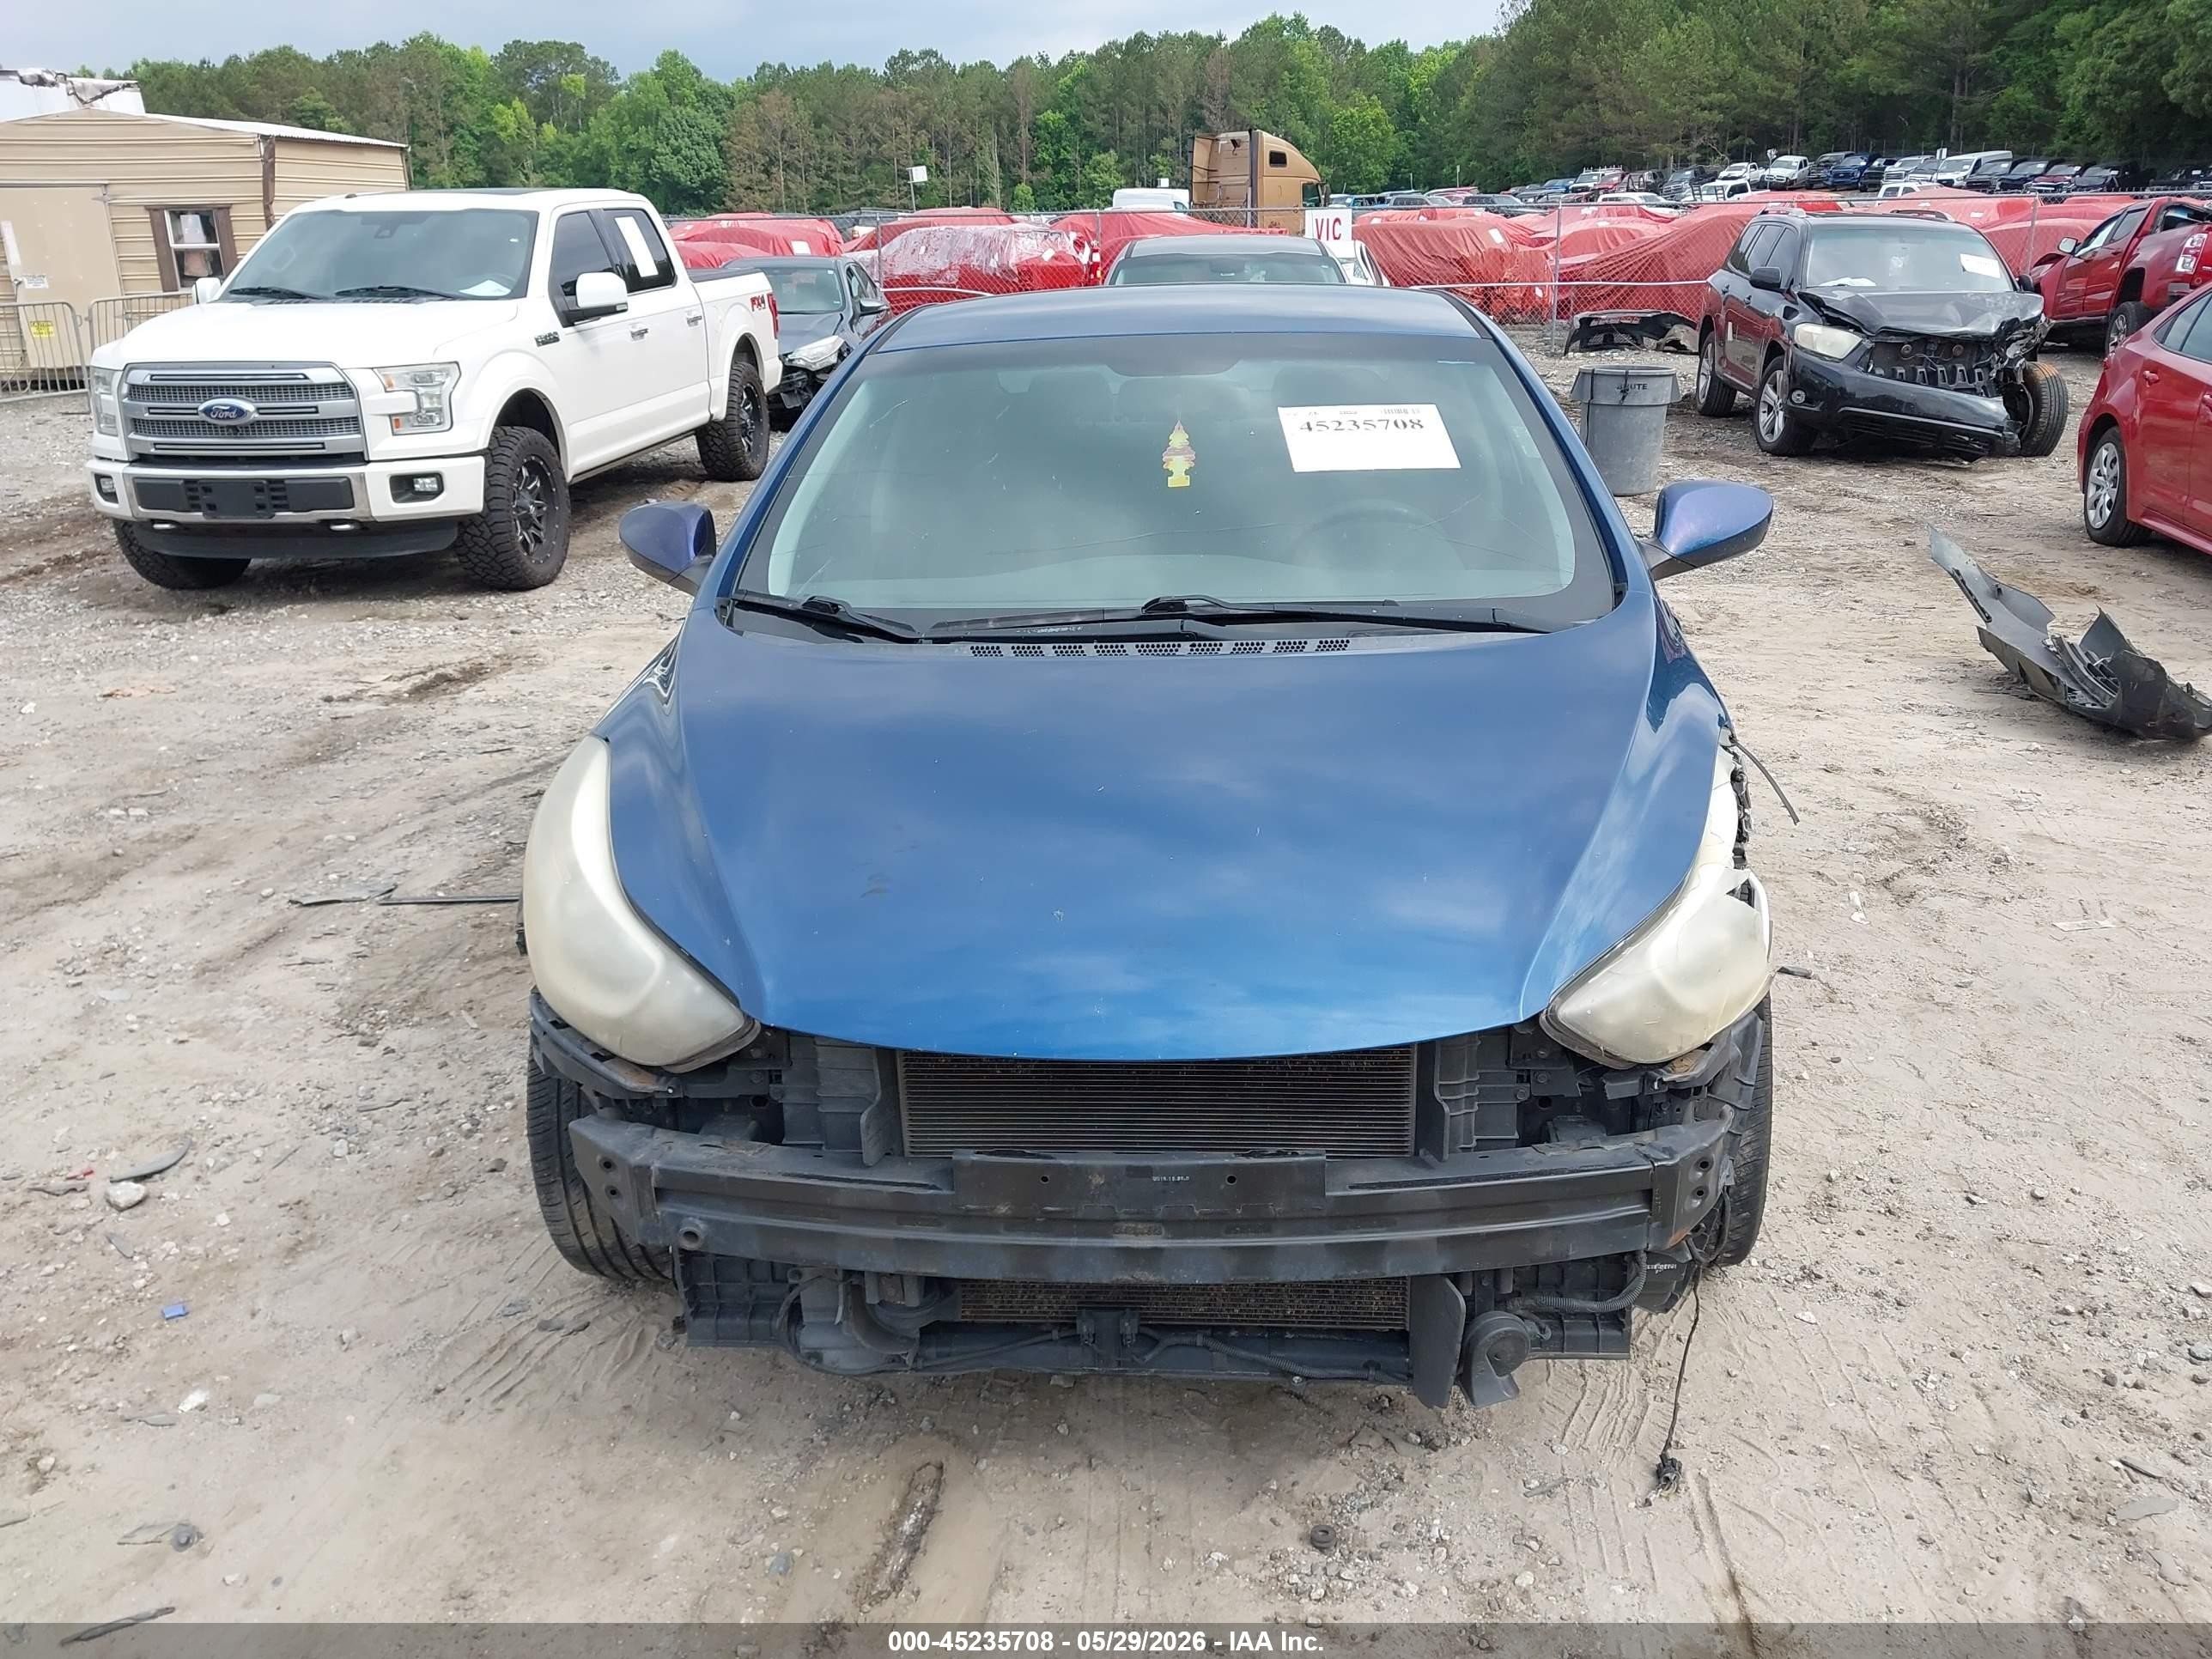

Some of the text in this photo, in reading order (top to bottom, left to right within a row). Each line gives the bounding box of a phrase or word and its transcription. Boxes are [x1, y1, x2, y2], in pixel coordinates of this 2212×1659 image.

[1315, 217, 1341, 240] VIC
[210, 405, 238, 418] Ford
[1300, 419, 1425, 432] 45235708
